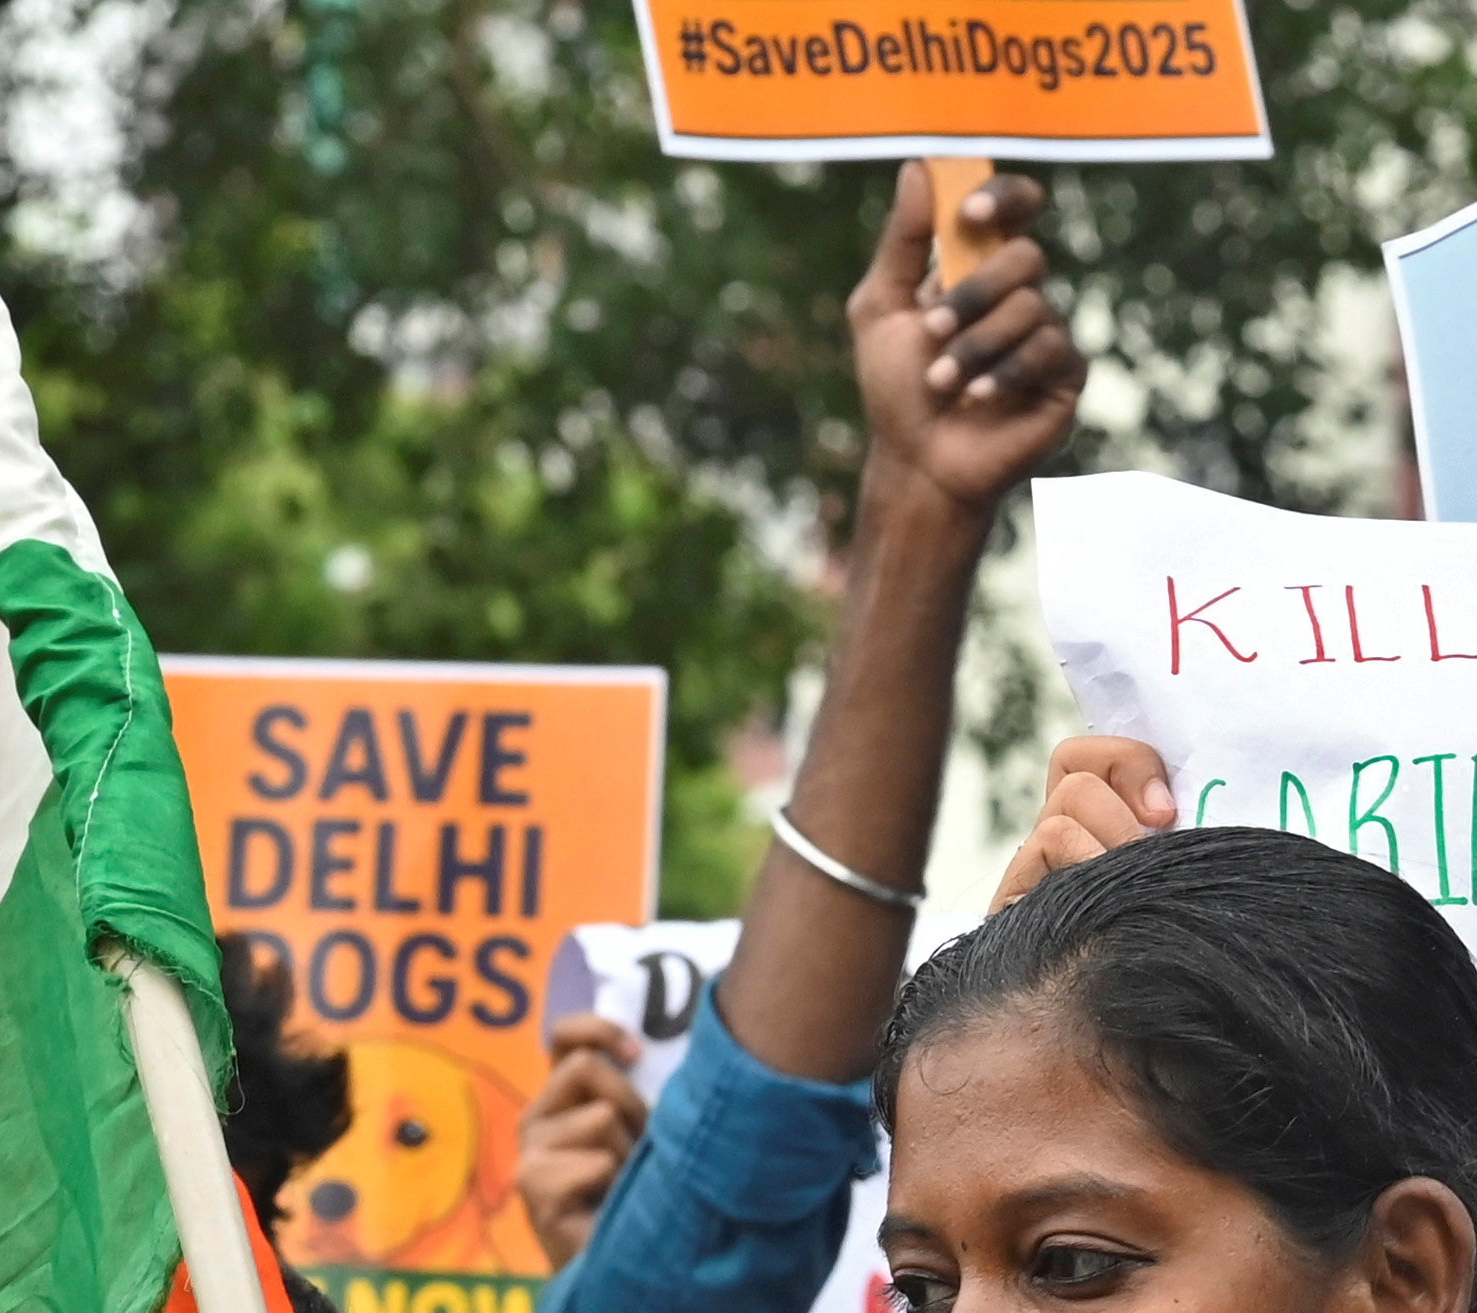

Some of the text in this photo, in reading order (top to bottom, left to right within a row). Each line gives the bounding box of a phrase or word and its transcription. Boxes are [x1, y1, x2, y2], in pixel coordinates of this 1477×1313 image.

[680, 20, 1216, 92] #SaveDelhiDogs2025
[248, 705, 536, 807] SAVE
[227, 817, 545, 918] DELHI
